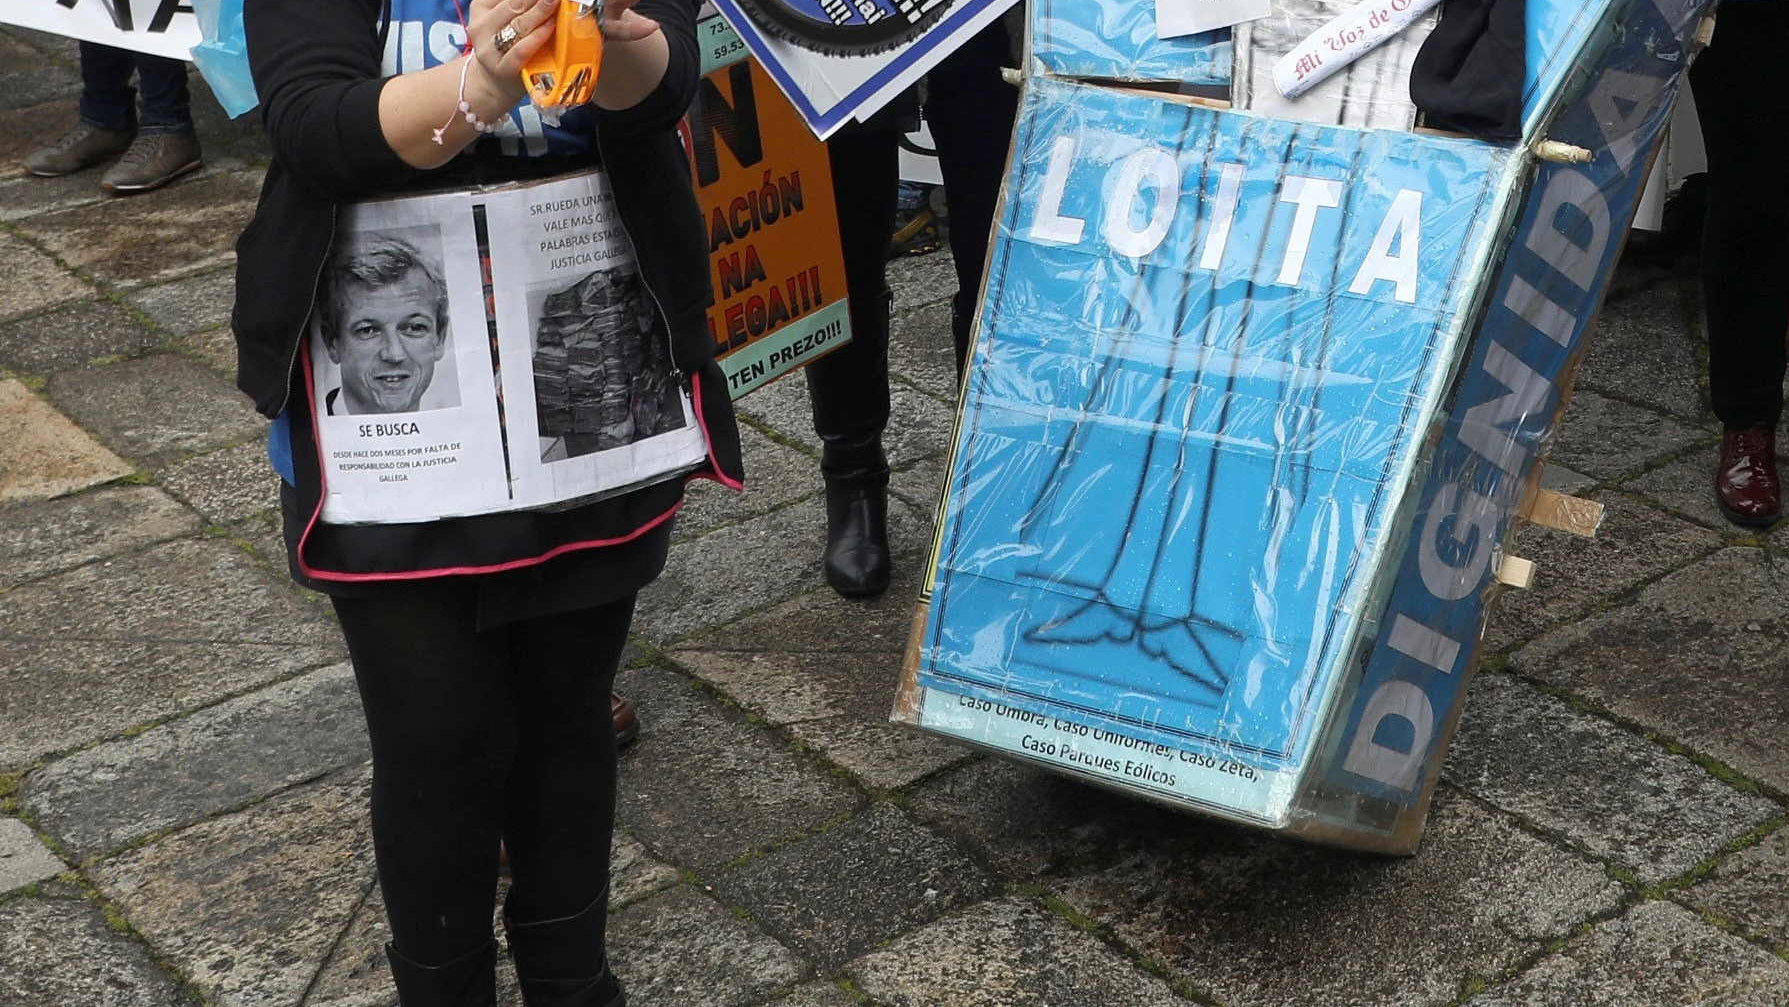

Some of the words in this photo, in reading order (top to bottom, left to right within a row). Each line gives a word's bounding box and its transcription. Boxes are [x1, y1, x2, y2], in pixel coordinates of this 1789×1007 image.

[1368, 8, 1390, 30] de
[702, 170, 803, 253] ACIÓN
[1030, 135, 1421, 304] LOITA
[544, 219, 568, 232] VALE
[571, 215, 593, 227] MAS
[540, 234, 590, 252] PALABRAS
[550, 253, 591, 270] JUSTICIA
[718, 245, 766, 299] NA
[728, 360, 768, 390] TEN
[770, 320, 842, 372] PREZO!!!
[358, 424, 373, 437] SE
[376, 422, 419, 437] BUSCA
[333, 451, 352, 459] DESDE
[353, 450, 369, 458] HACE
[370, 449, 382, 458] DOS
[384, 448, 406, 457] MESES
[407, 447, 422, 456] POR
[424, 444, 448, 454] FALTA
[450, 442, 461, 451] DE
[339, 461, 394, 472] RESPONSABILIDAD
[396, 460, 409, 469] CON
[411, 460, 421, 468] LA
[423, 456, 457, 467] JUSTICIA
[379, 474, 408, 483] GALLEGA
[1021, 734, 1056, 757] Caso
[1060, 745, 1120, 772] Parques
[1124, 760, 1177, 786] Eólicos
[1179, 751, 1216, 769] Caso
